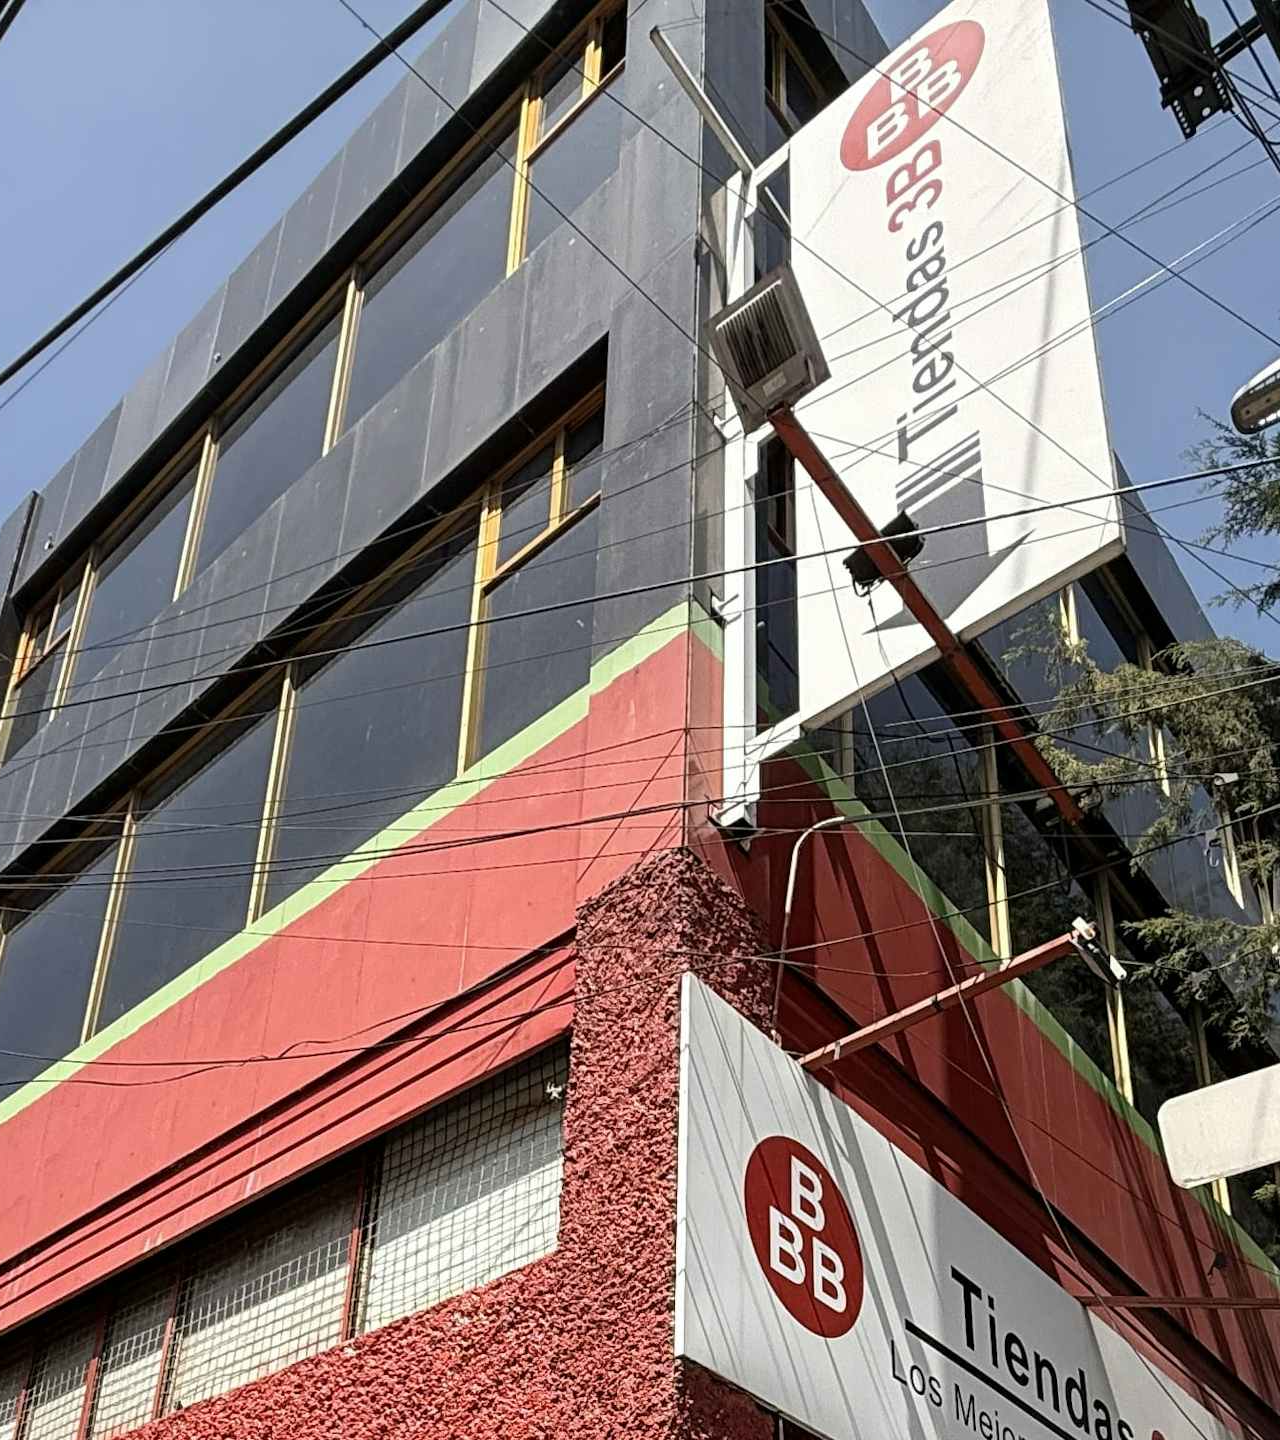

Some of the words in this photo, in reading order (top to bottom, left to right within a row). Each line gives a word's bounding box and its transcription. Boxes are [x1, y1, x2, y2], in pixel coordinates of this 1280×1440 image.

[886, 139, 943, 233] 3B
[892, 220, 959, 465] Tiendas
[791, 1155, 825, 1232] B
[769, 1205, 847, 1313] BB
[890, 1339, 942, 1407] Los
